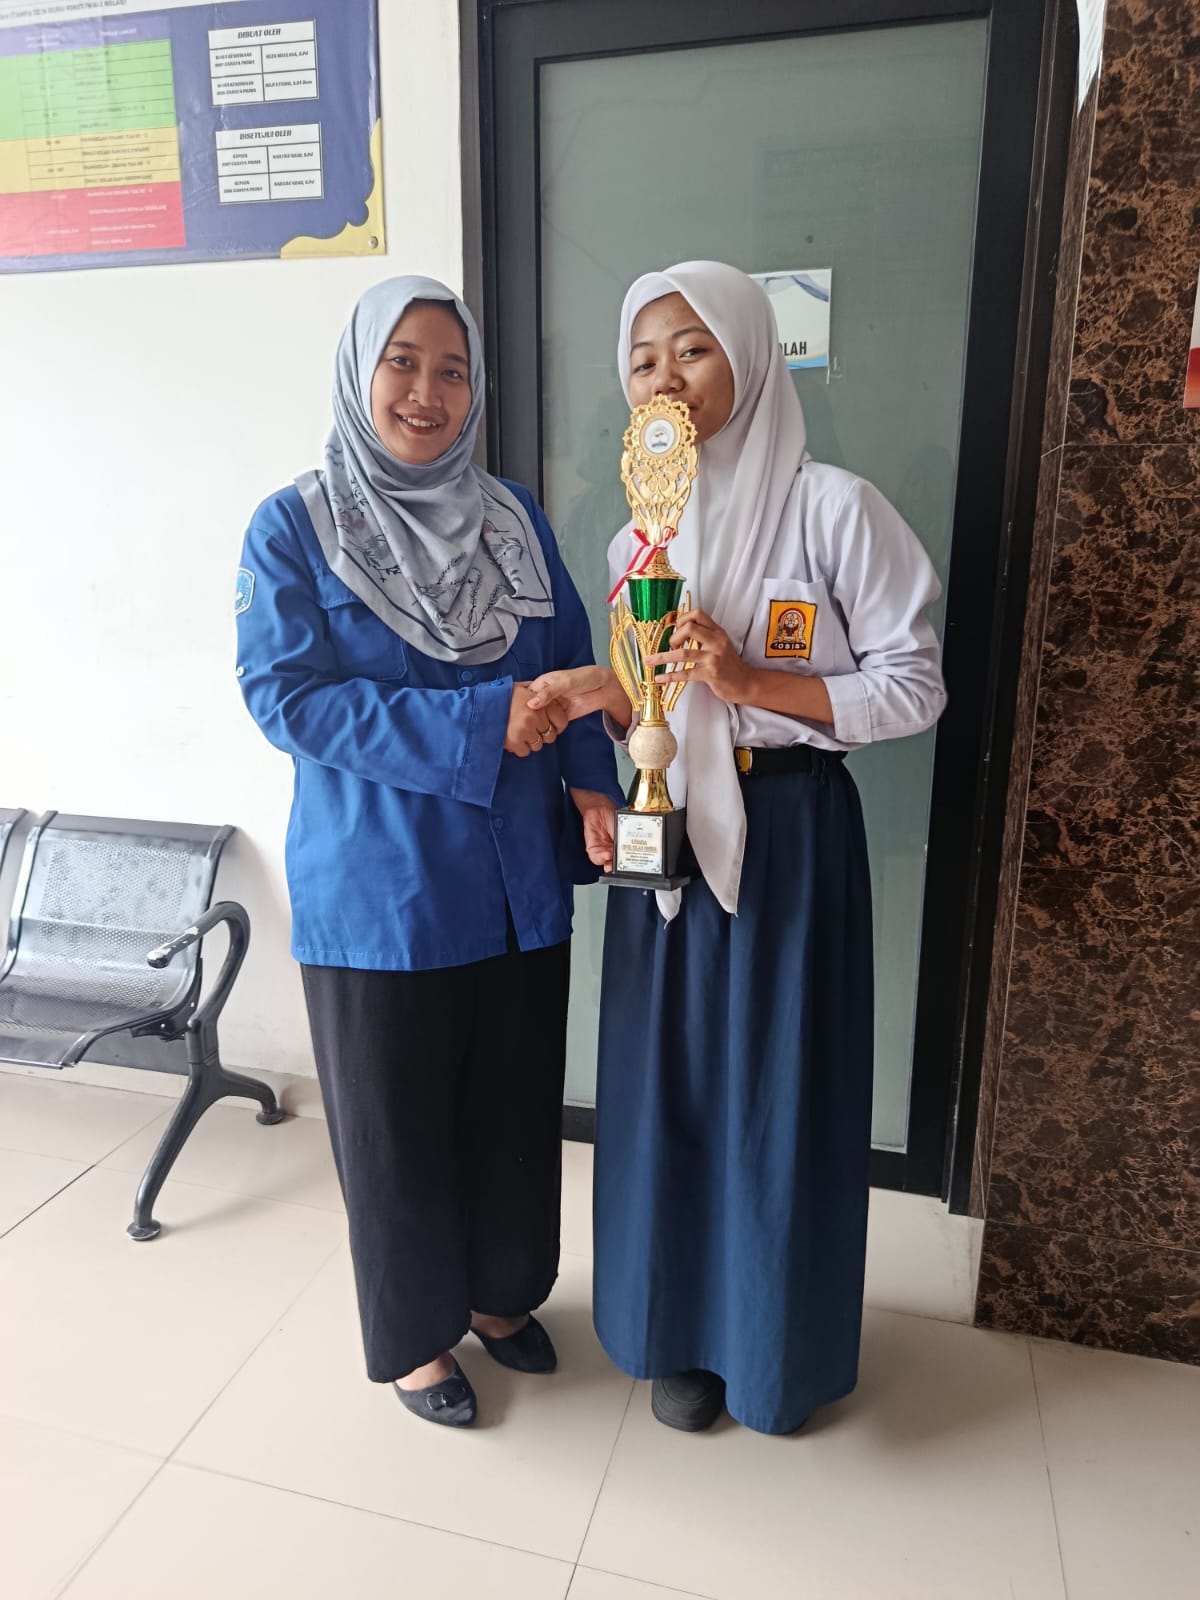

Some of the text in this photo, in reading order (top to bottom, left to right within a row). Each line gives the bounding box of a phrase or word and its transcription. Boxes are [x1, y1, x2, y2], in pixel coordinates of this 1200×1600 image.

[238, 28, 281, 39] DIBUAT OLEH
[240, 129, 292, 140] DISETUJUI OLEH
